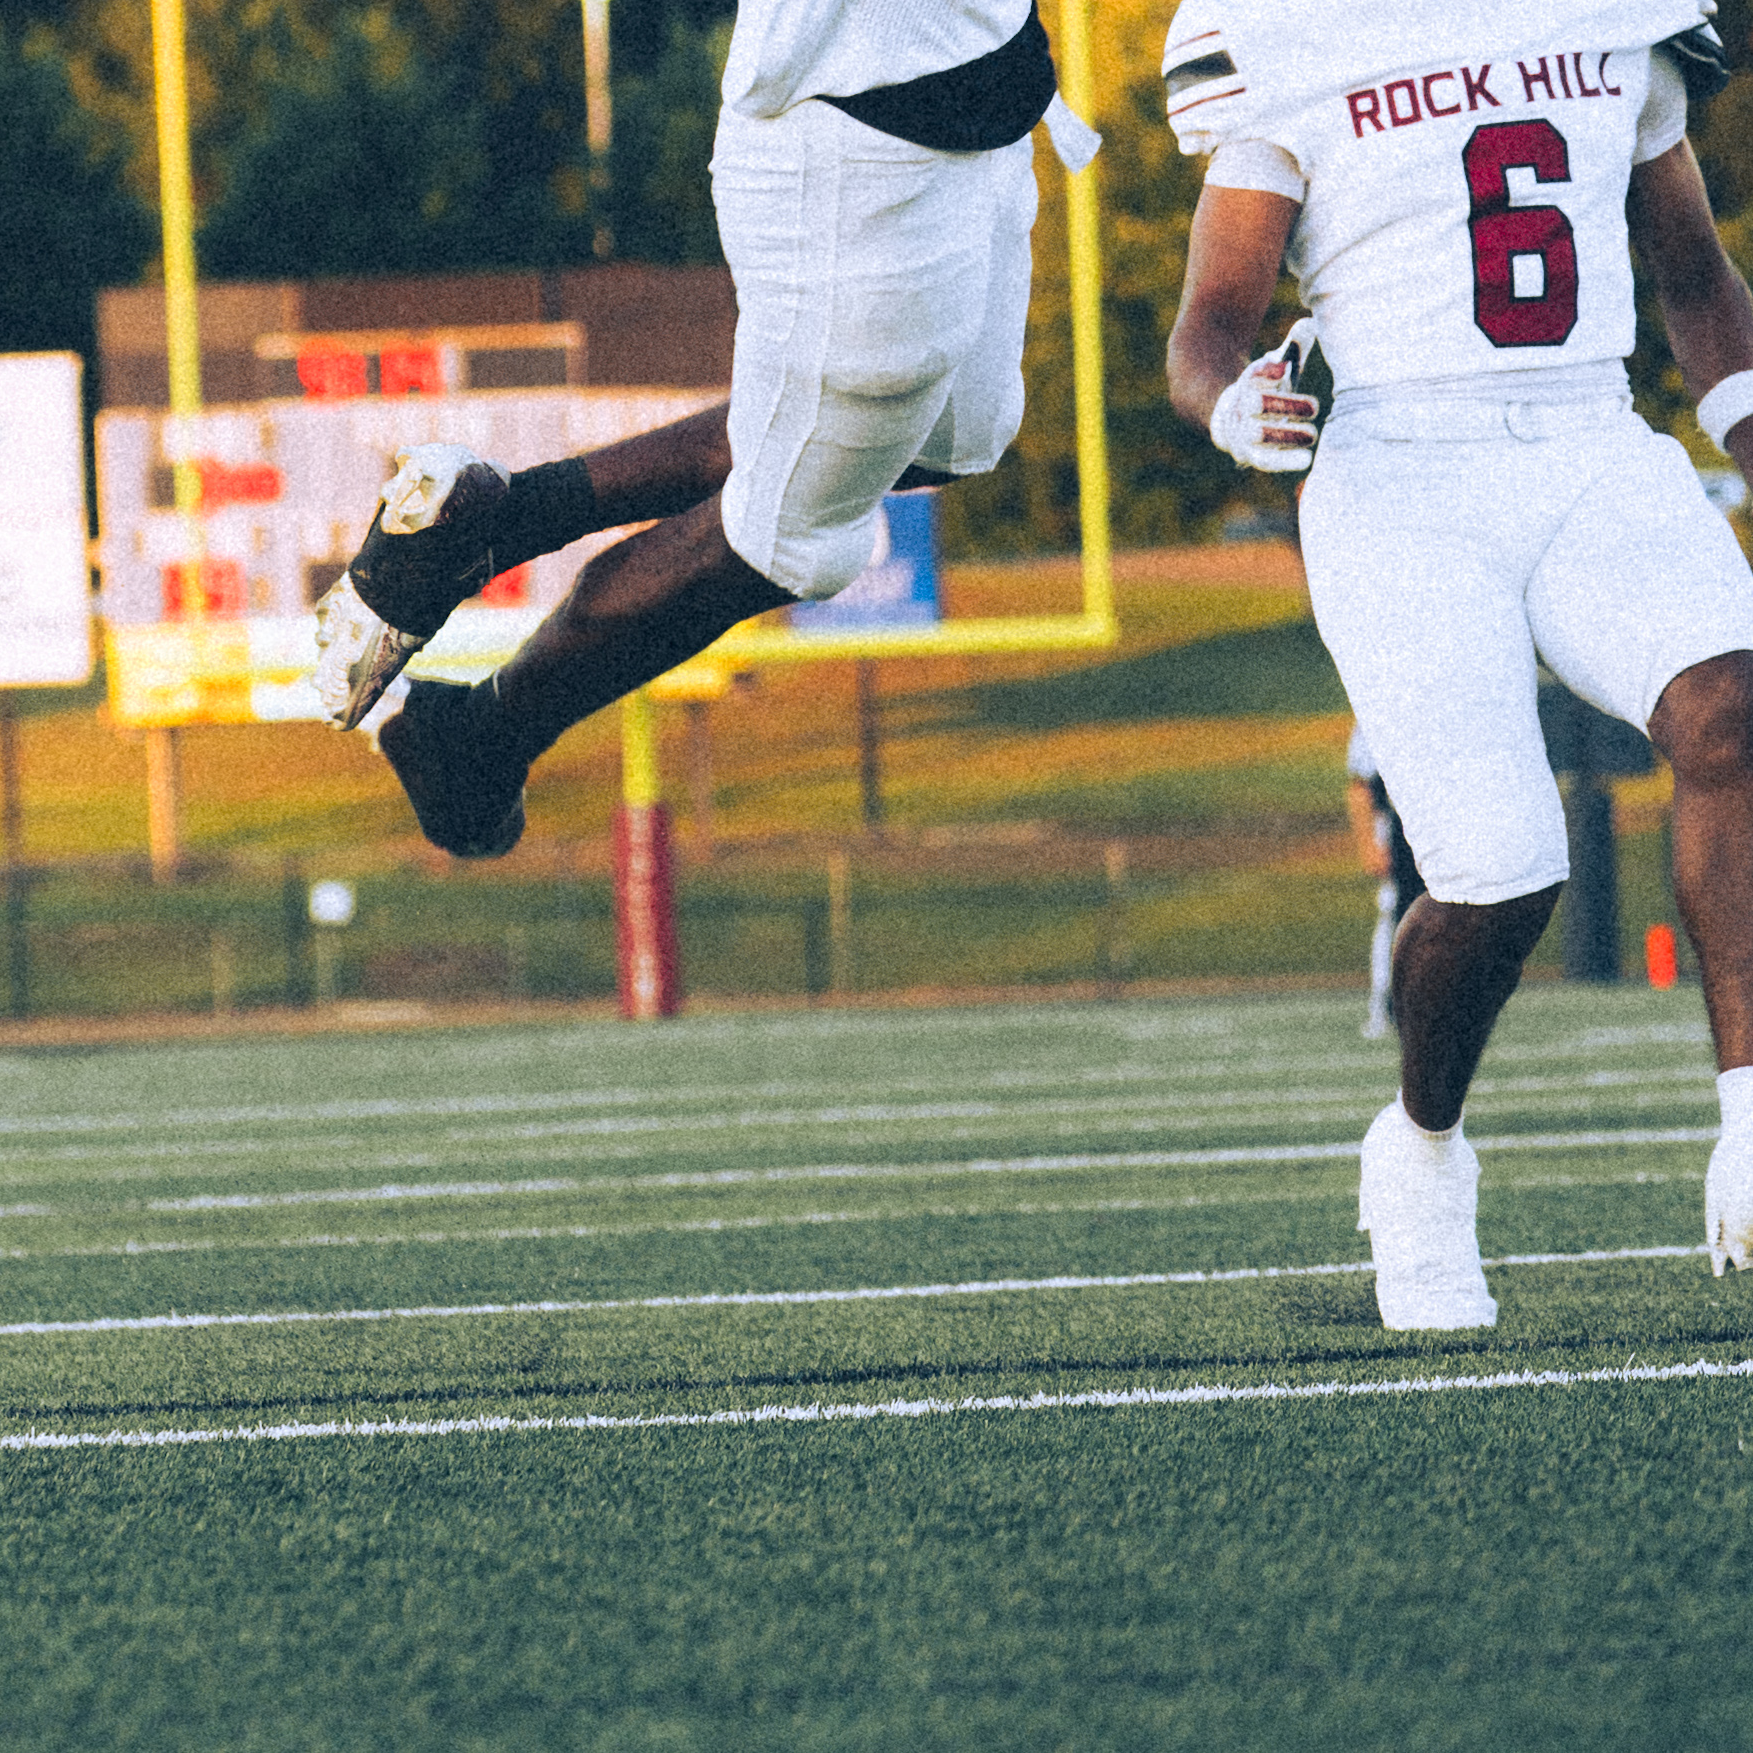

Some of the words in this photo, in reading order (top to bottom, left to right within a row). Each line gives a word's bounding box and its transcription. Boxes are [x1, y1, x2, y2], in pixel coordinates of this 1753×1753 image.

[1345, 63, 1502, 139] ROCK
[1516, 51, 1622, 103] HILL
[1462, 118, 1579, 348] 6
